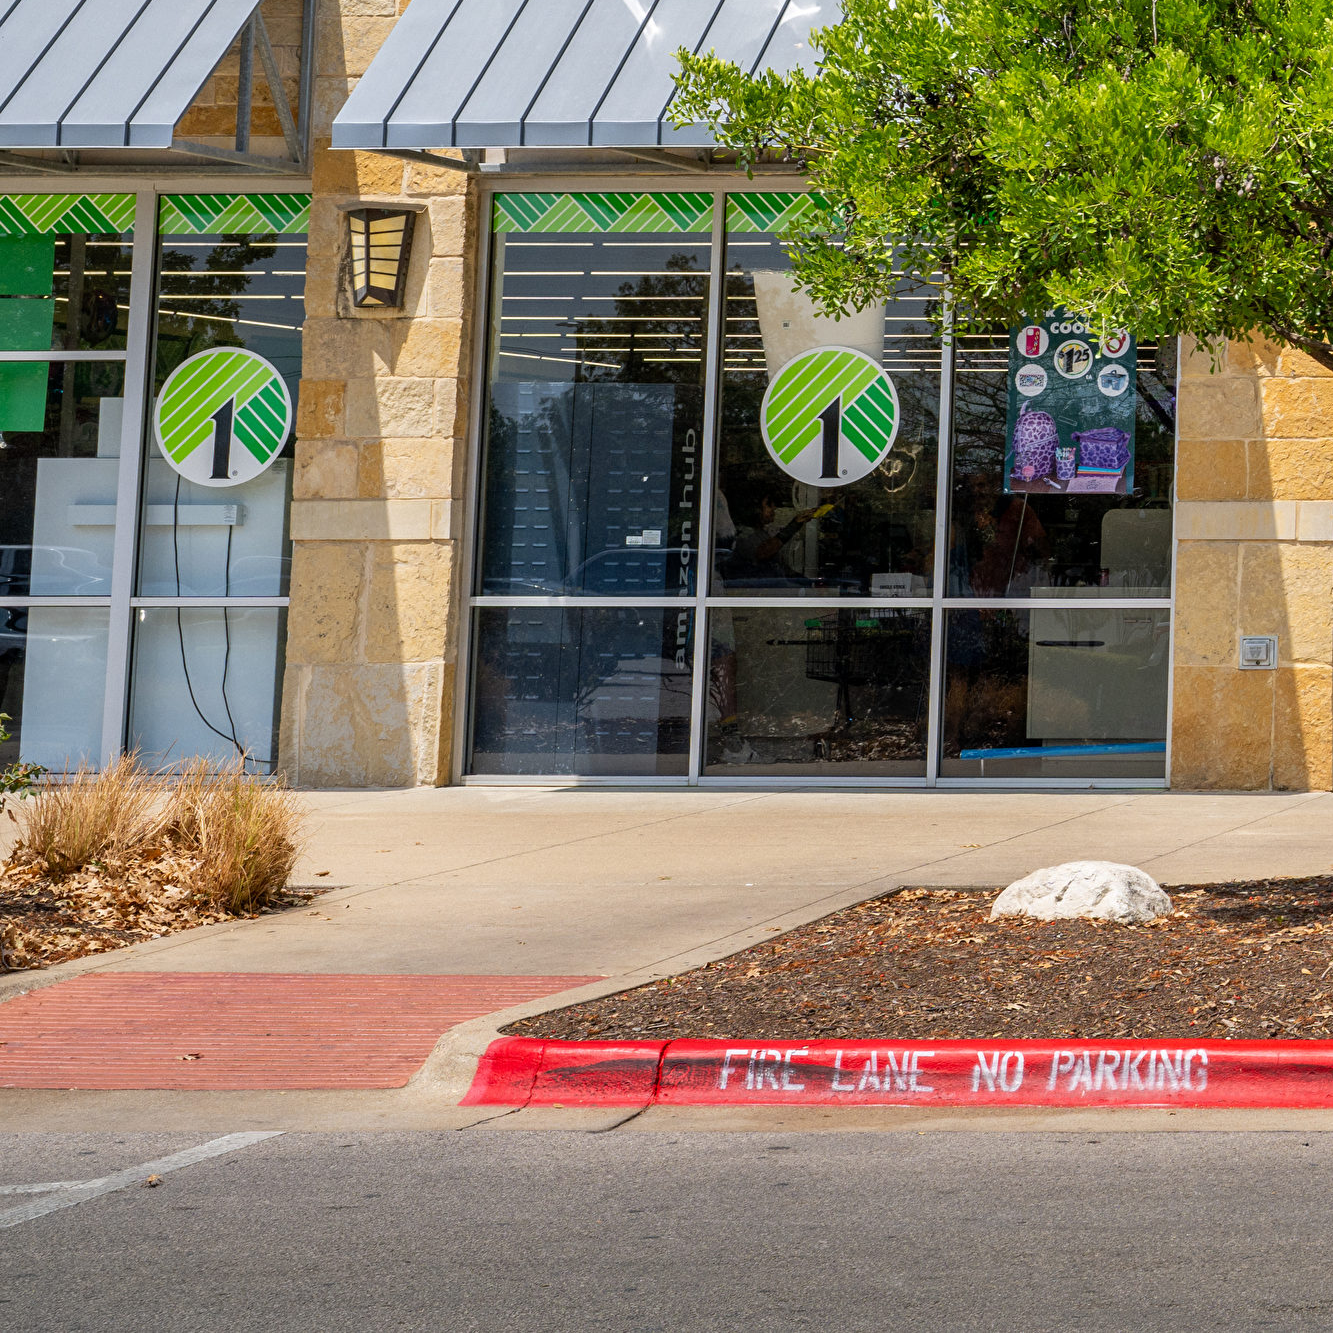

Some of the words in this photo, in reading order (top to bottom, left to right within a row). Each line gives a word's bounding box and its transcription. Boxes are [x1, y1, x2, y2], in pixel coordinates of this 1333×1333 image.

[679, 428, 696, 508] hub
[720, 1048, 808, 1091] FIRE
[831, 1049, 935, 1092] LANE
[972, 1049, 1024, 1092] NO
[1047, 1048, 1210, 1093] PARKING
